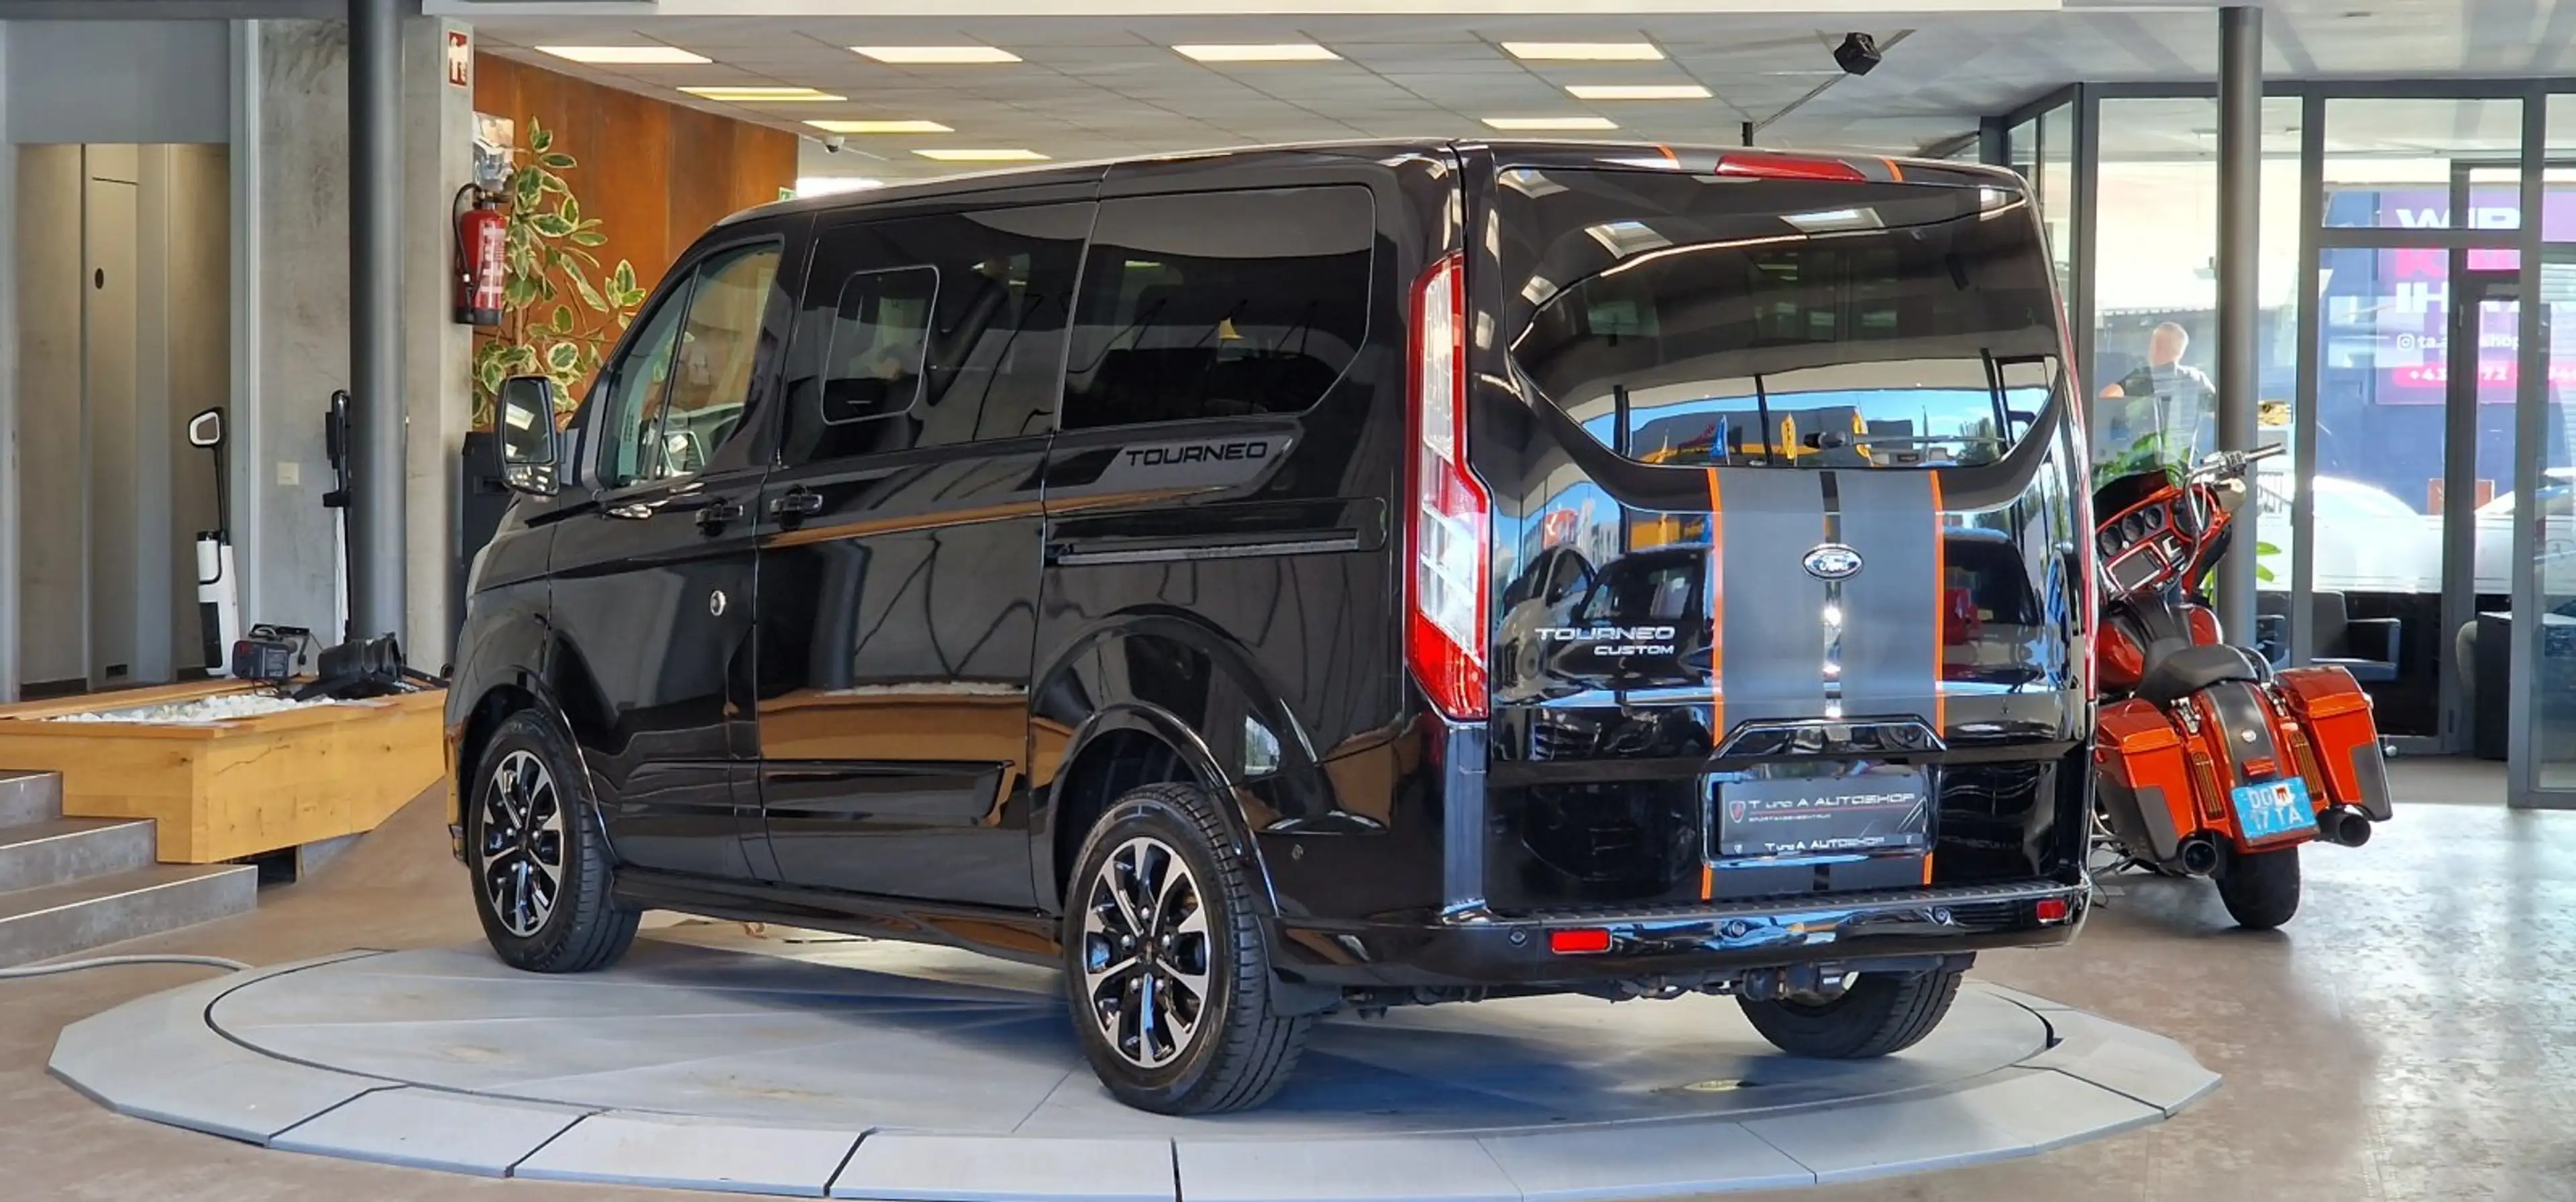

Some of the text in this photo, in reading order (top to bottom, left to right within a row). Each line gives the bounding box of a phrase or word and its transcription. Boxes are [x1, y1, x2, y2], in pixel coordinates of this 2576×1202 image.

[1126, 441, 1269, 467] TOURNEO
[1534, 626, 1676, 640] TOURNEO
[1594, 645, 1675, 655] CUSTOM
[1748, 800, 1761, 809] T
[1797, 798, 1809, 807] A
[1814, 793, 1915, 806] AUTOSHOP
[2275, 804, 2305, 826] TA
[1811, 836, 1885, 850] AUTOSHOP
